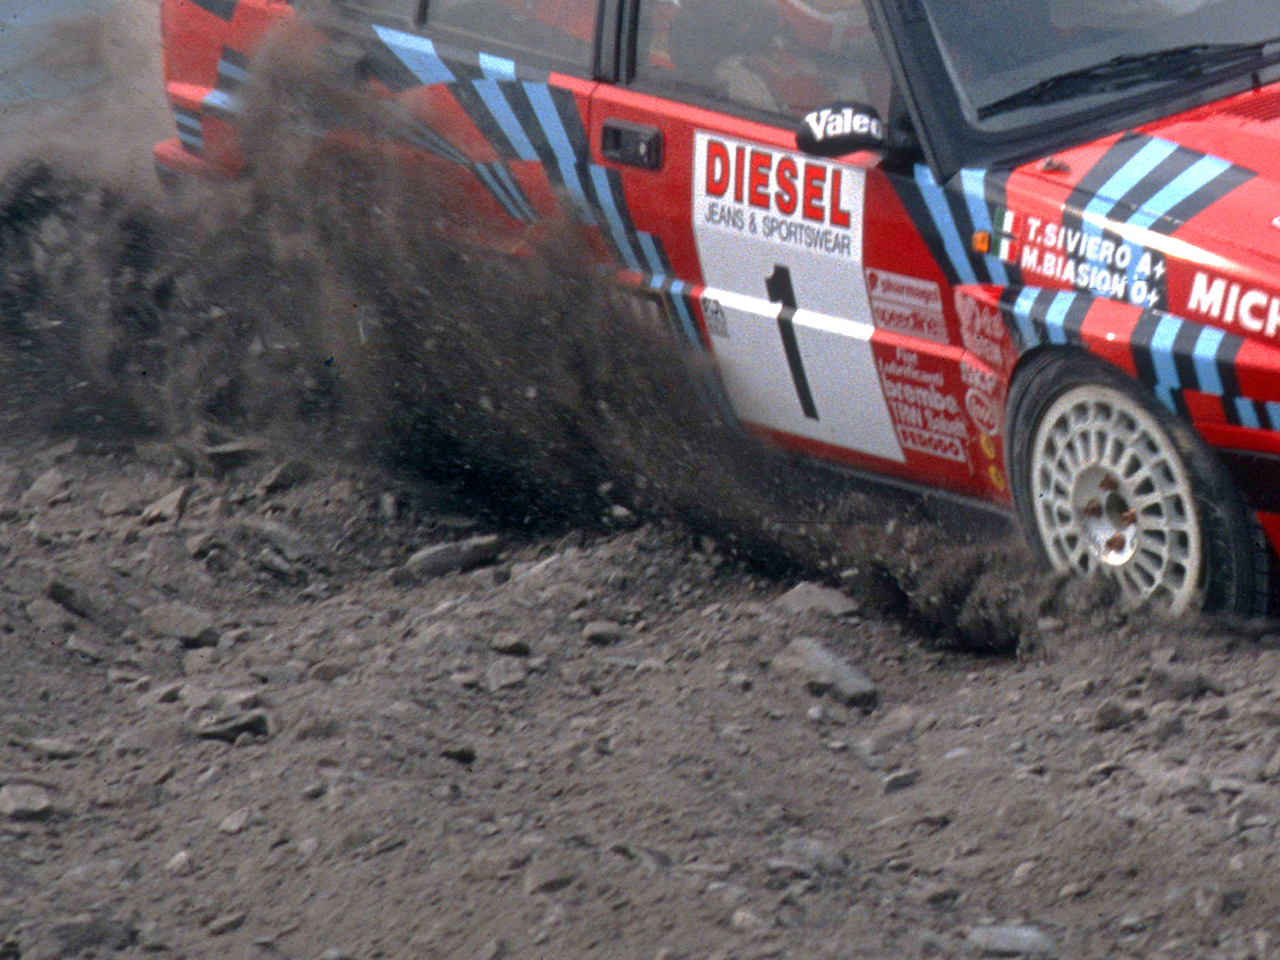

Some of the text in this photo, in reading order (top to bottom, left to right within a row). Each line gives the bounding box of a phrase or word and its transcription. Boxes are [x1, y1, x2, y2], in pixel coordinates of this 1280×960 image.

[705, 138, 851, 229] DIESEL
[704, 201, 851, 256] JEANS & SPORTSWEAR
[1027, 217, 1132, 269] T.SIVIERO
[1020, 245, 1128, 299] M.BIASION
[764, 263, 820, 421] 1
